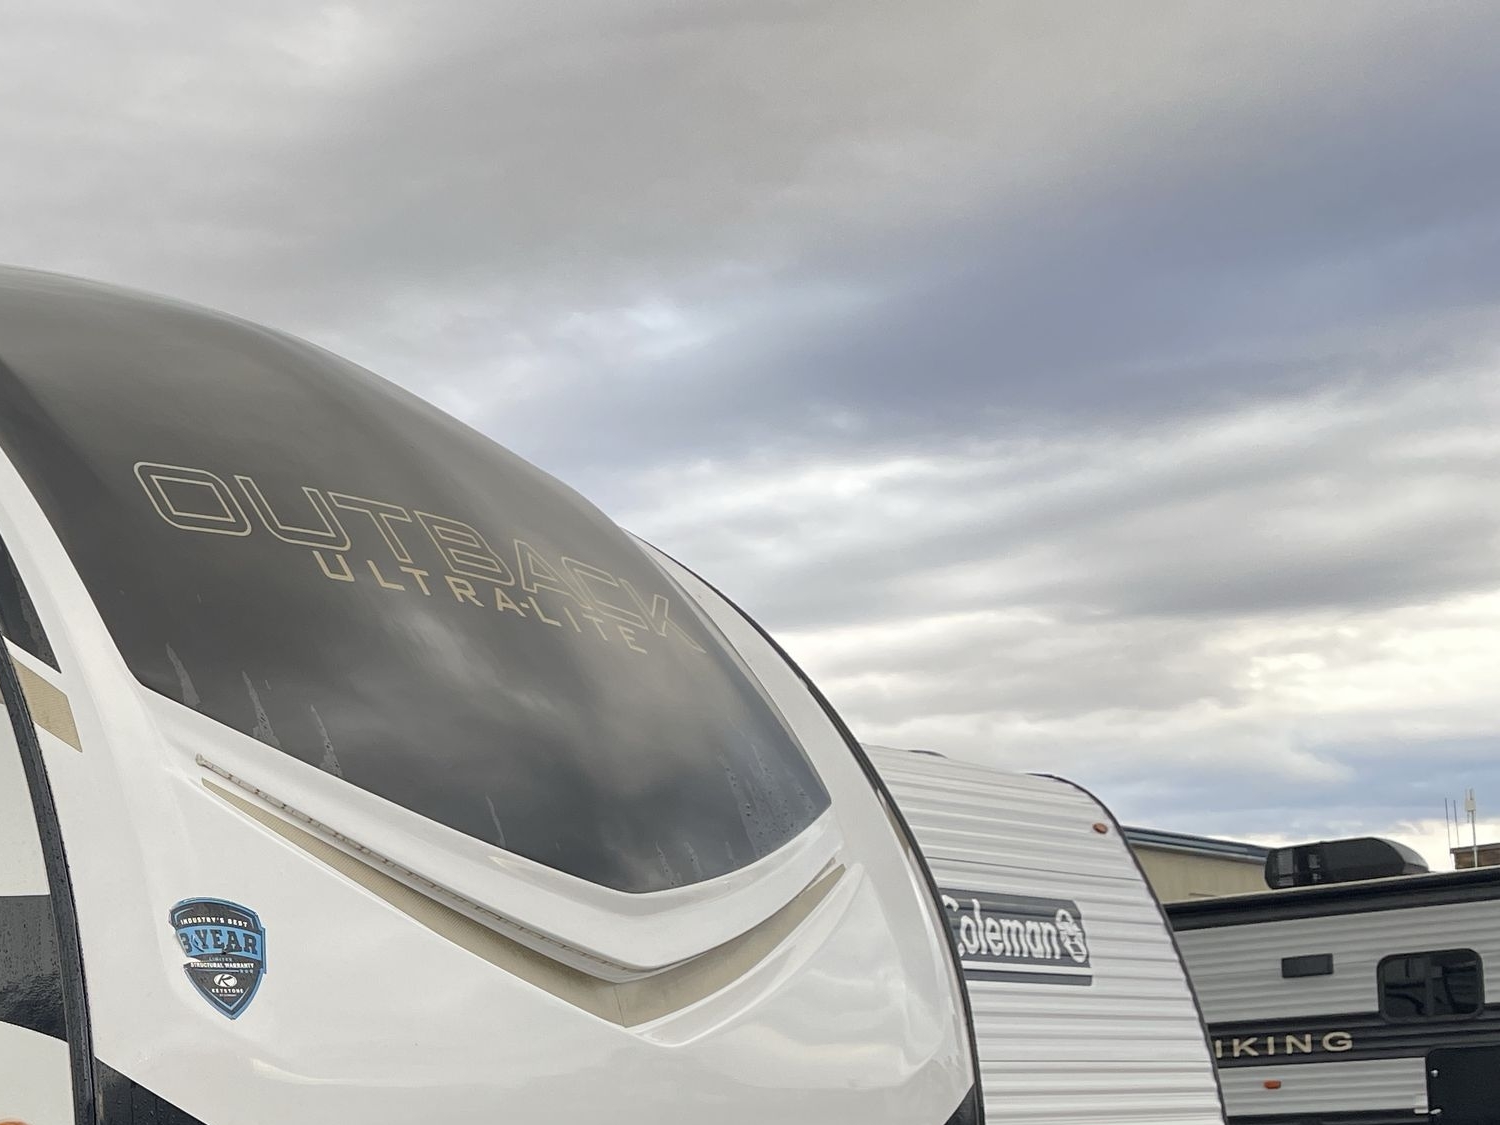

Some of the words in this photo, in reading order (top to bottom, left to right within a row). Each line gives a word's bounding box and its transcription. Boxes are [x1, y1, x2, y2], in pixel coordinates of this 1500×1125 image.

[133, 461, 706, 654] OUTBACK
[313, 550, 648, 654] ULTRA-LITE
[181, 916, 225, 926] INDUSTRY'S
[228, 918, 248, 928] BEST
[194, 928, 258, 955] YEAR
[1214, 1031, 1353, 1059] IKING
